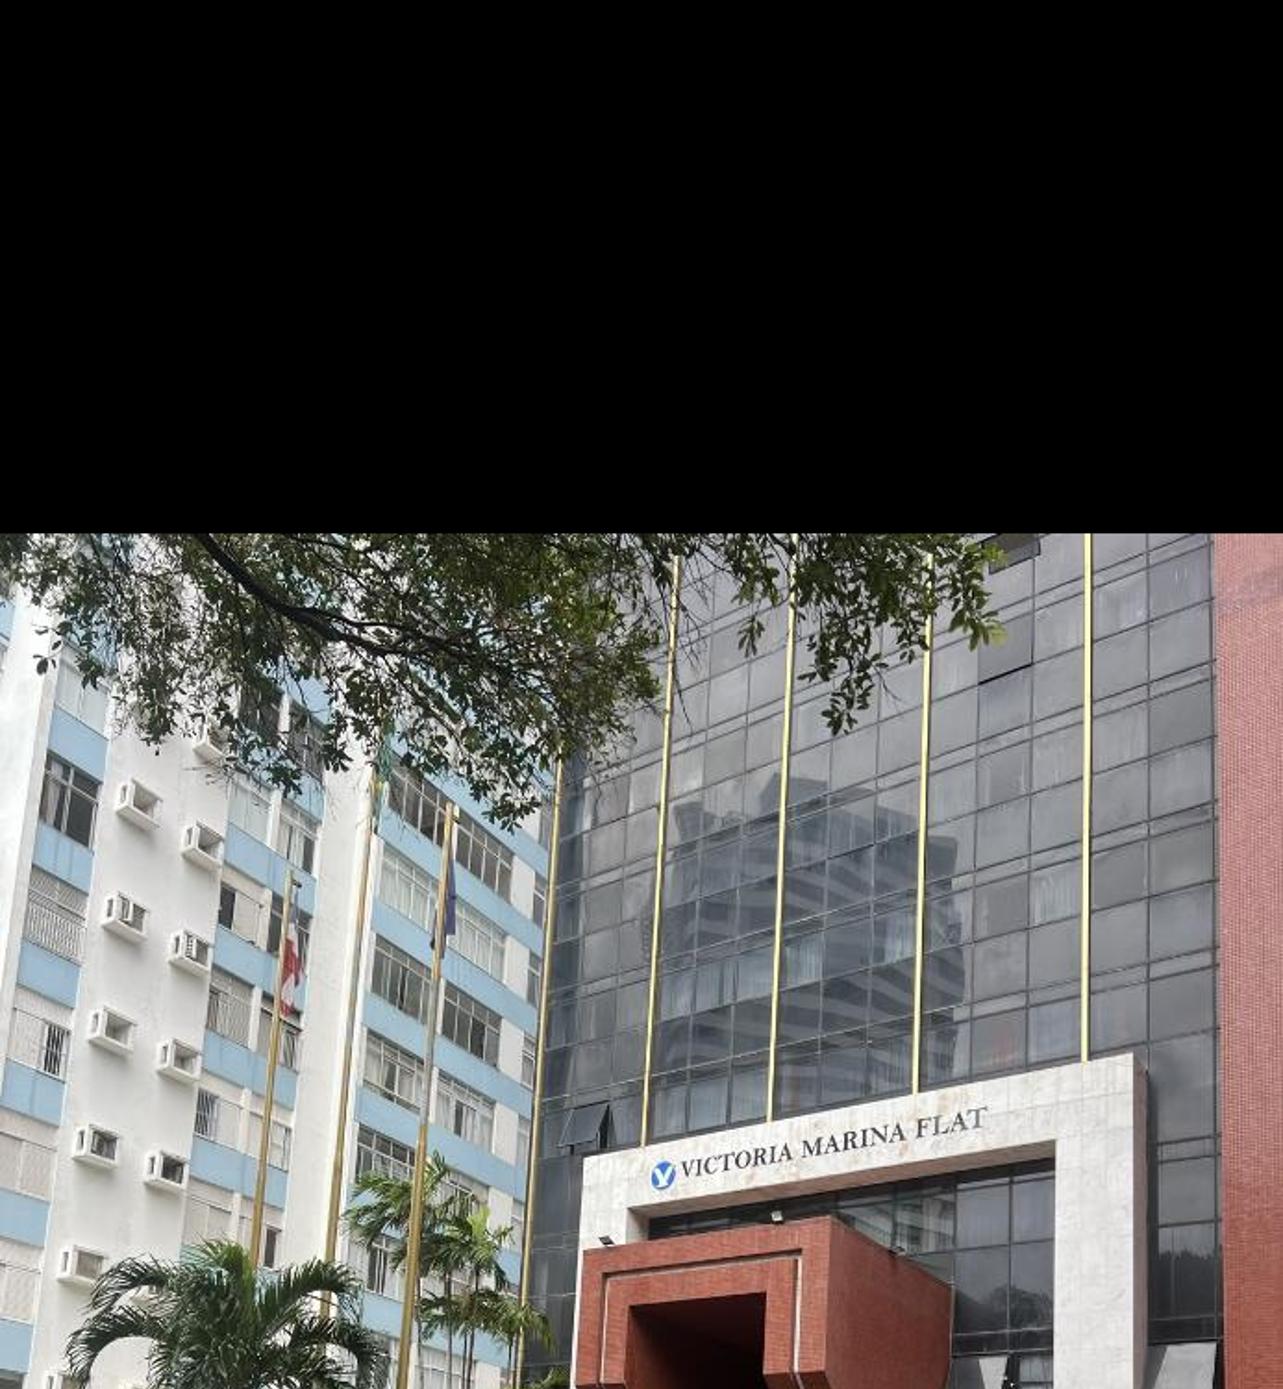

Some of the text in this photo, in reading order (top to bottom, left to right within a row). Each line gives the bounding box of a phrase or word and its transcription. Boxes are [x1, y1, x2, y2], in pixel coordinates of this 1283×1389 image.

[681, 1142, 793, 1177] VICTORIA
[800, 1122, 907, 1158] MARINA
[915, 1106, 988, 1140] FLAT
